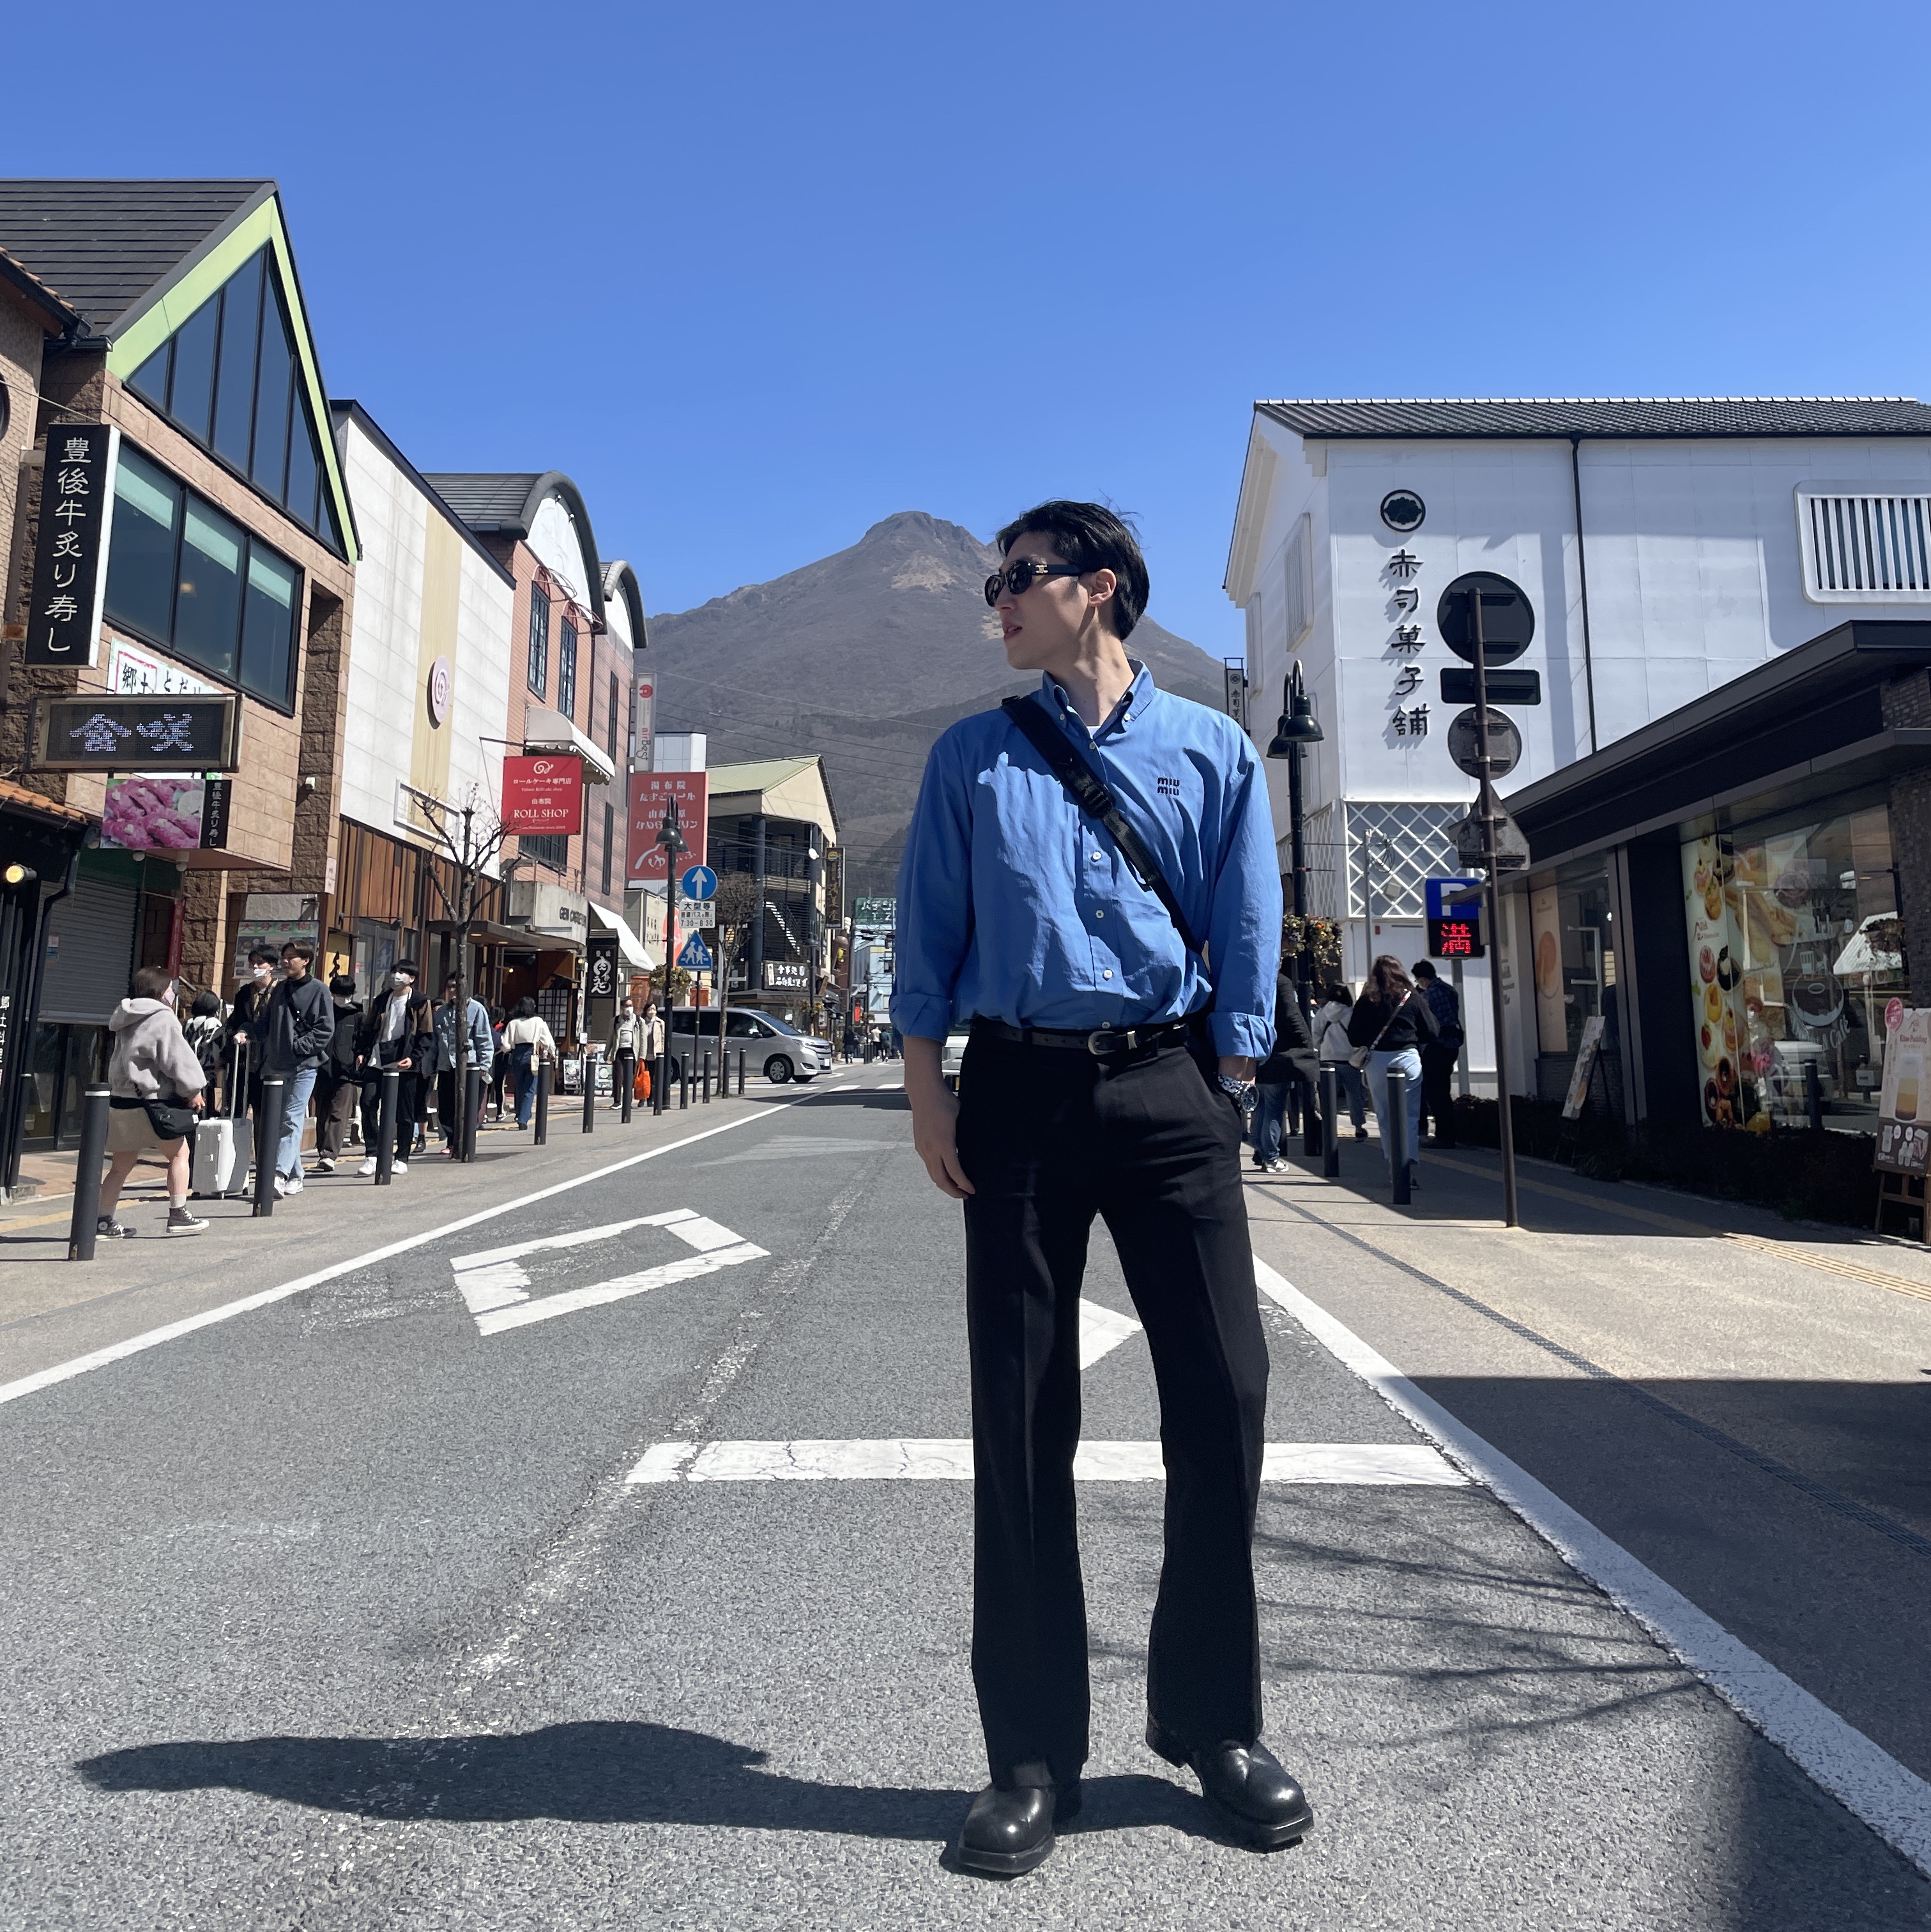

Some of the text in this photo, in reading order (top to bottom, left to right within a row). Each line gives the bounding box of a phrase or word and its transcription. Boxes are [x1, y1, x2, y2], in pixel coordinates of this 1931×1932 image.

[44, 438, 92, 652] 豊後牛炙り寿し
[1390, 549, 1430, 736] 赤司菓子舗
[1157, 777, 1180, 786] miu
[1157, 786, 1180, 795] miu
[514, 809, 569, 818] ROLL SHOP
[636, 820, 698, 830] なめらリン
